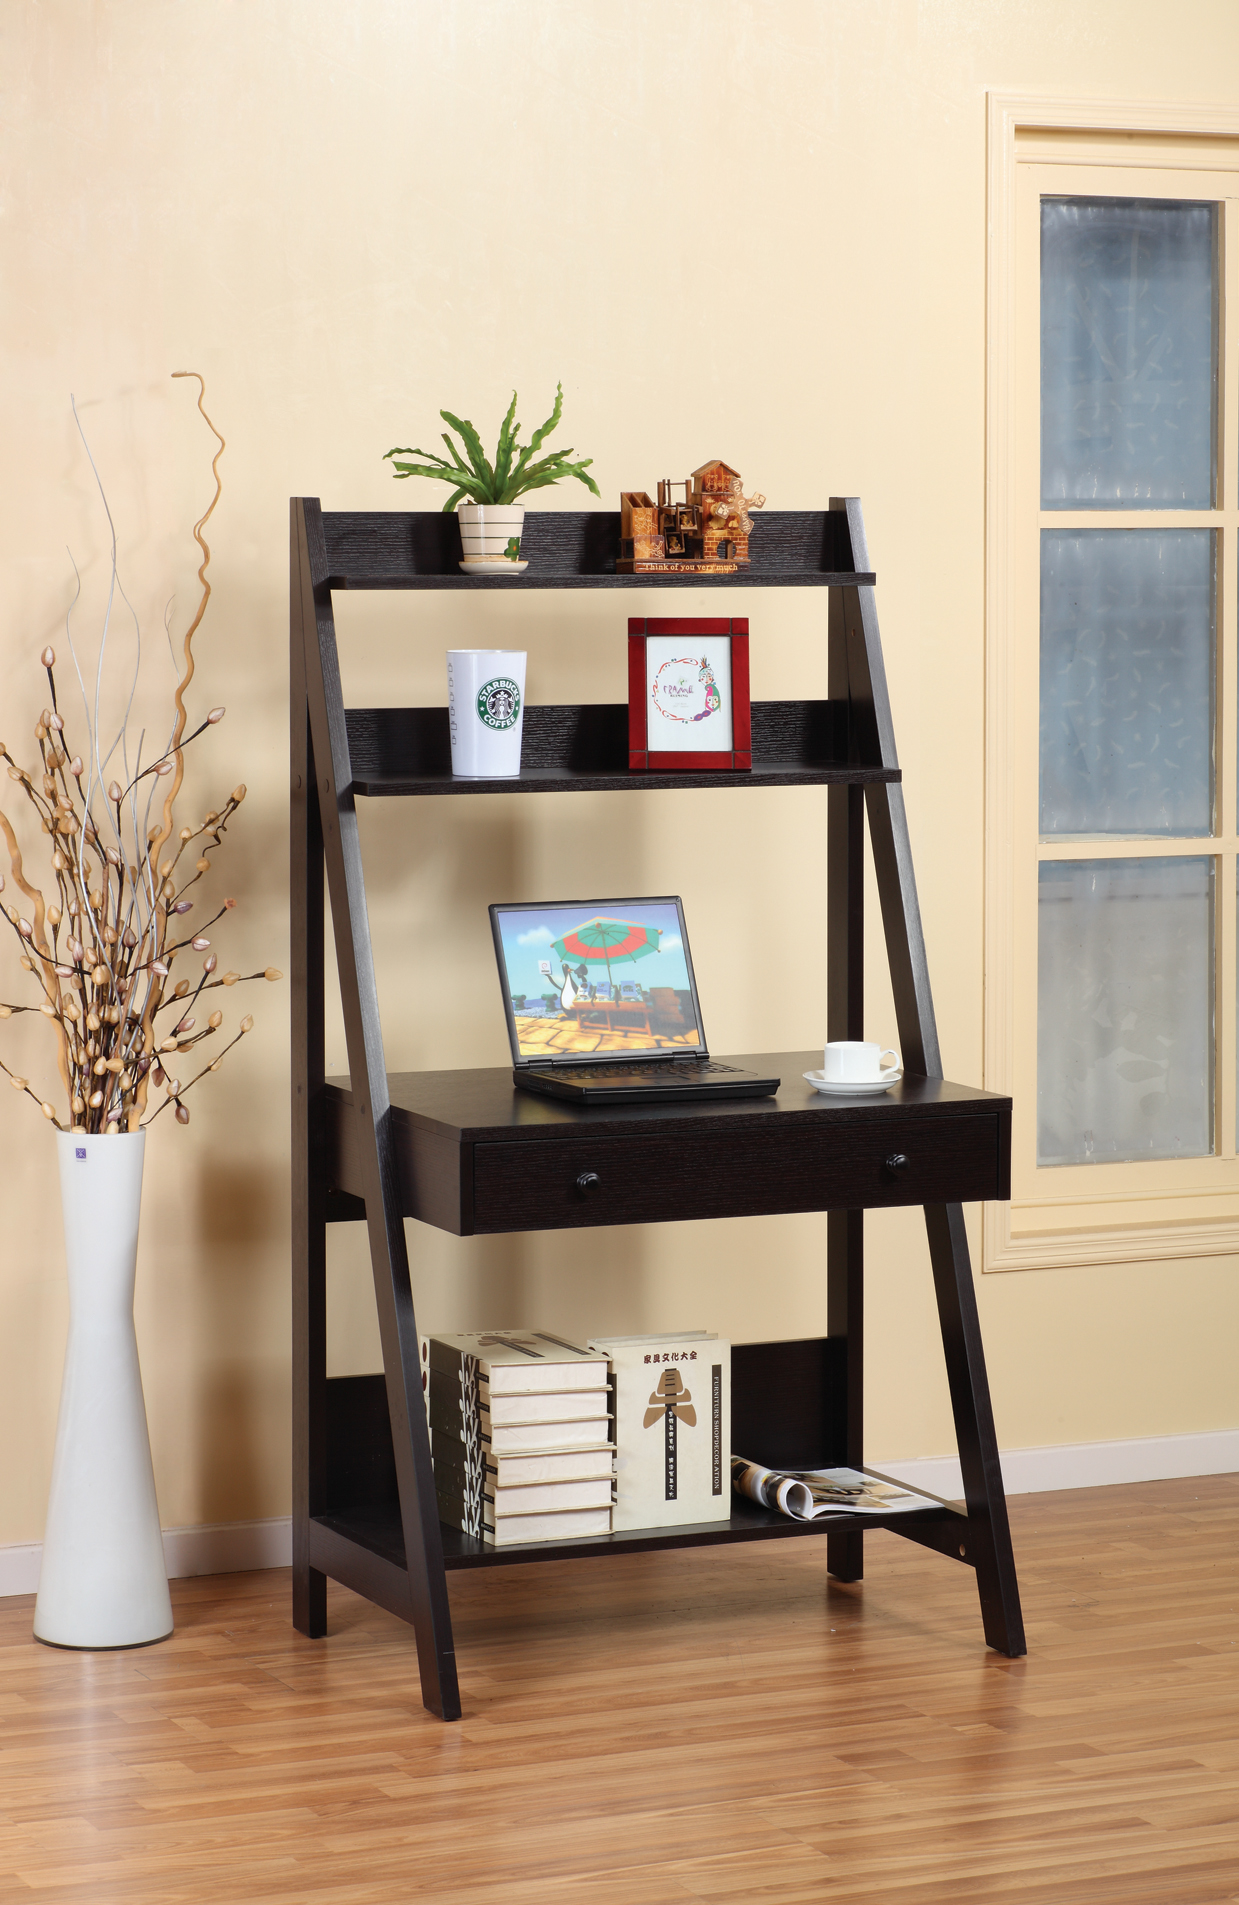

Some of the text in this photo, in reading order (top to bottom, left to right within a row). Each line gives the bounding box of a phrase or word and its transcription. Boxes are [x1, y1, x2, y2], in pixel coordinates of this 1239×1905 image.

[732, 480, 742, 496] YOU
[645, 563, 668, 571] Think
[714, 563, 738, 571] much
[479, 680, 520, 702] STARBUCKS
[483, 714, 516, 728] COFFEE
[643, 1350, 698, 1364] 家具文化大全
